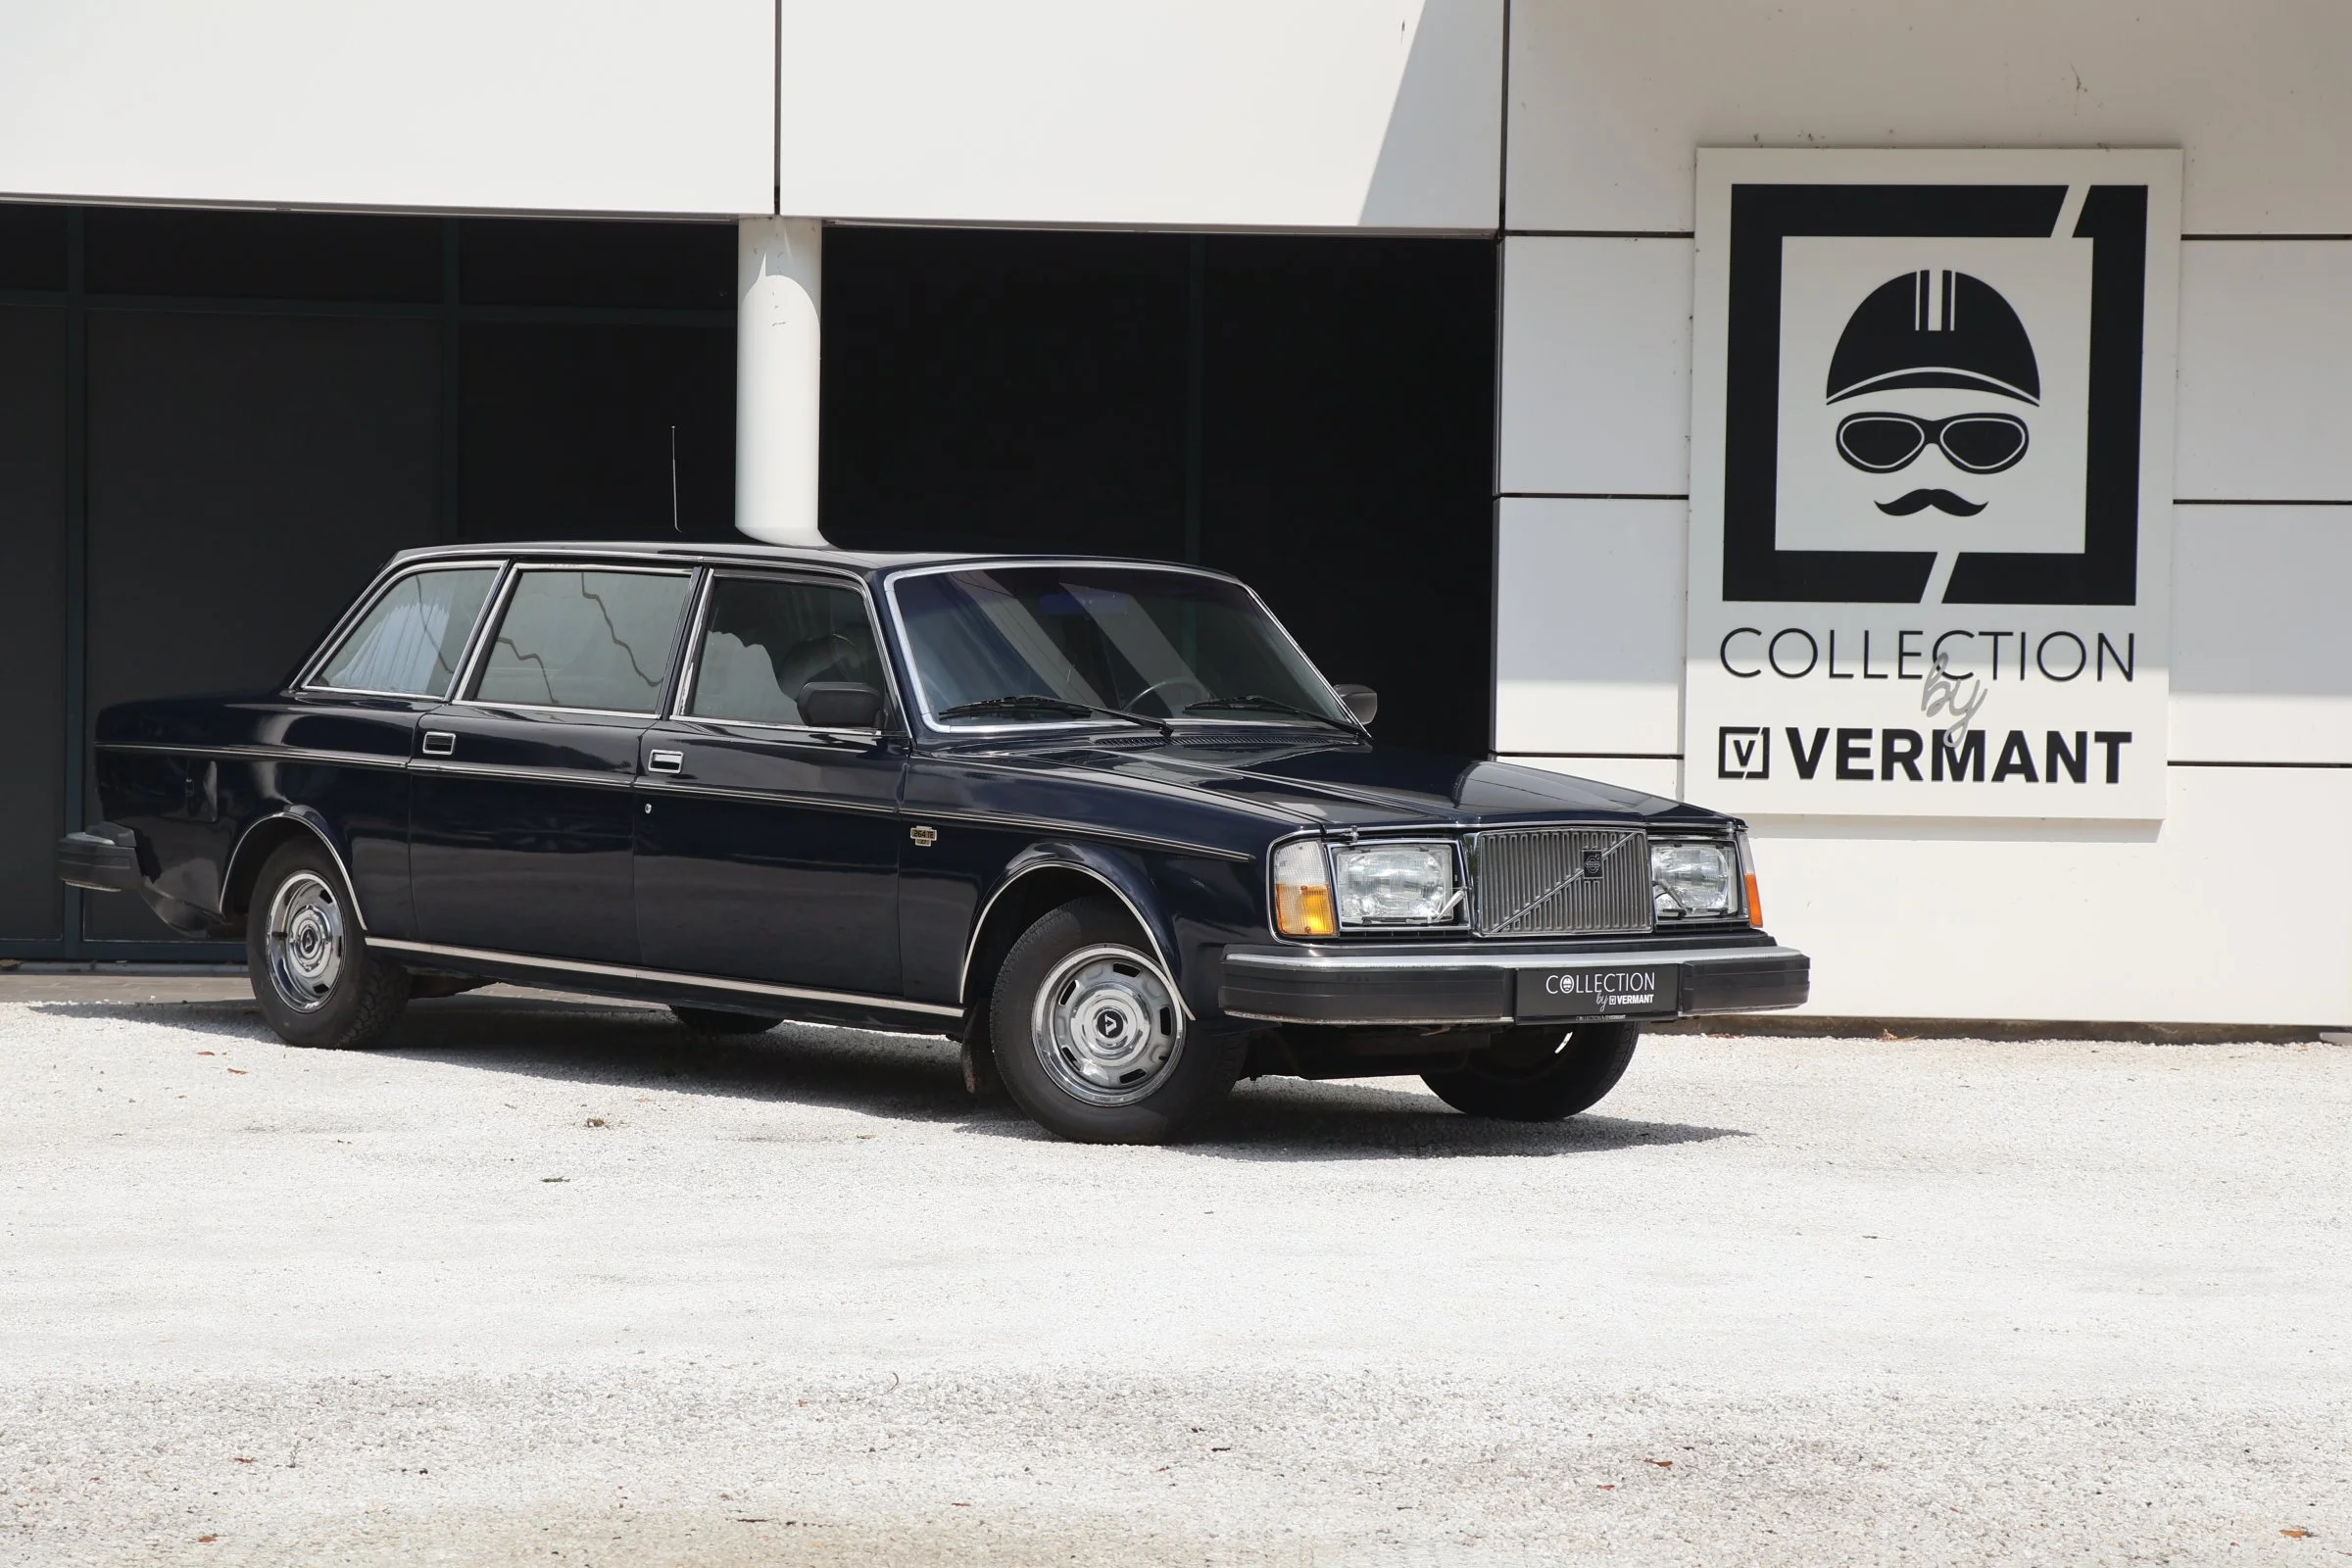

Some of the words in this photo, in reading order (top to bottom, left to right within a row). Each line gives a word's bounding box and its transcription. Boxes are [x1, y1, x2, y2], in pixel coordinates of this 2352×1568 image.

[1720, 627, 2134, 682] COLLECTION
[1921, 652, 1987, 748] by
[1785, 726, 2132, 784] VERMANT
[1545, 972, 1655, 994] COLLECTION
[1595, 992, 1608, 1012] by
[1617, 994, 1654, 1004] VERMANT
